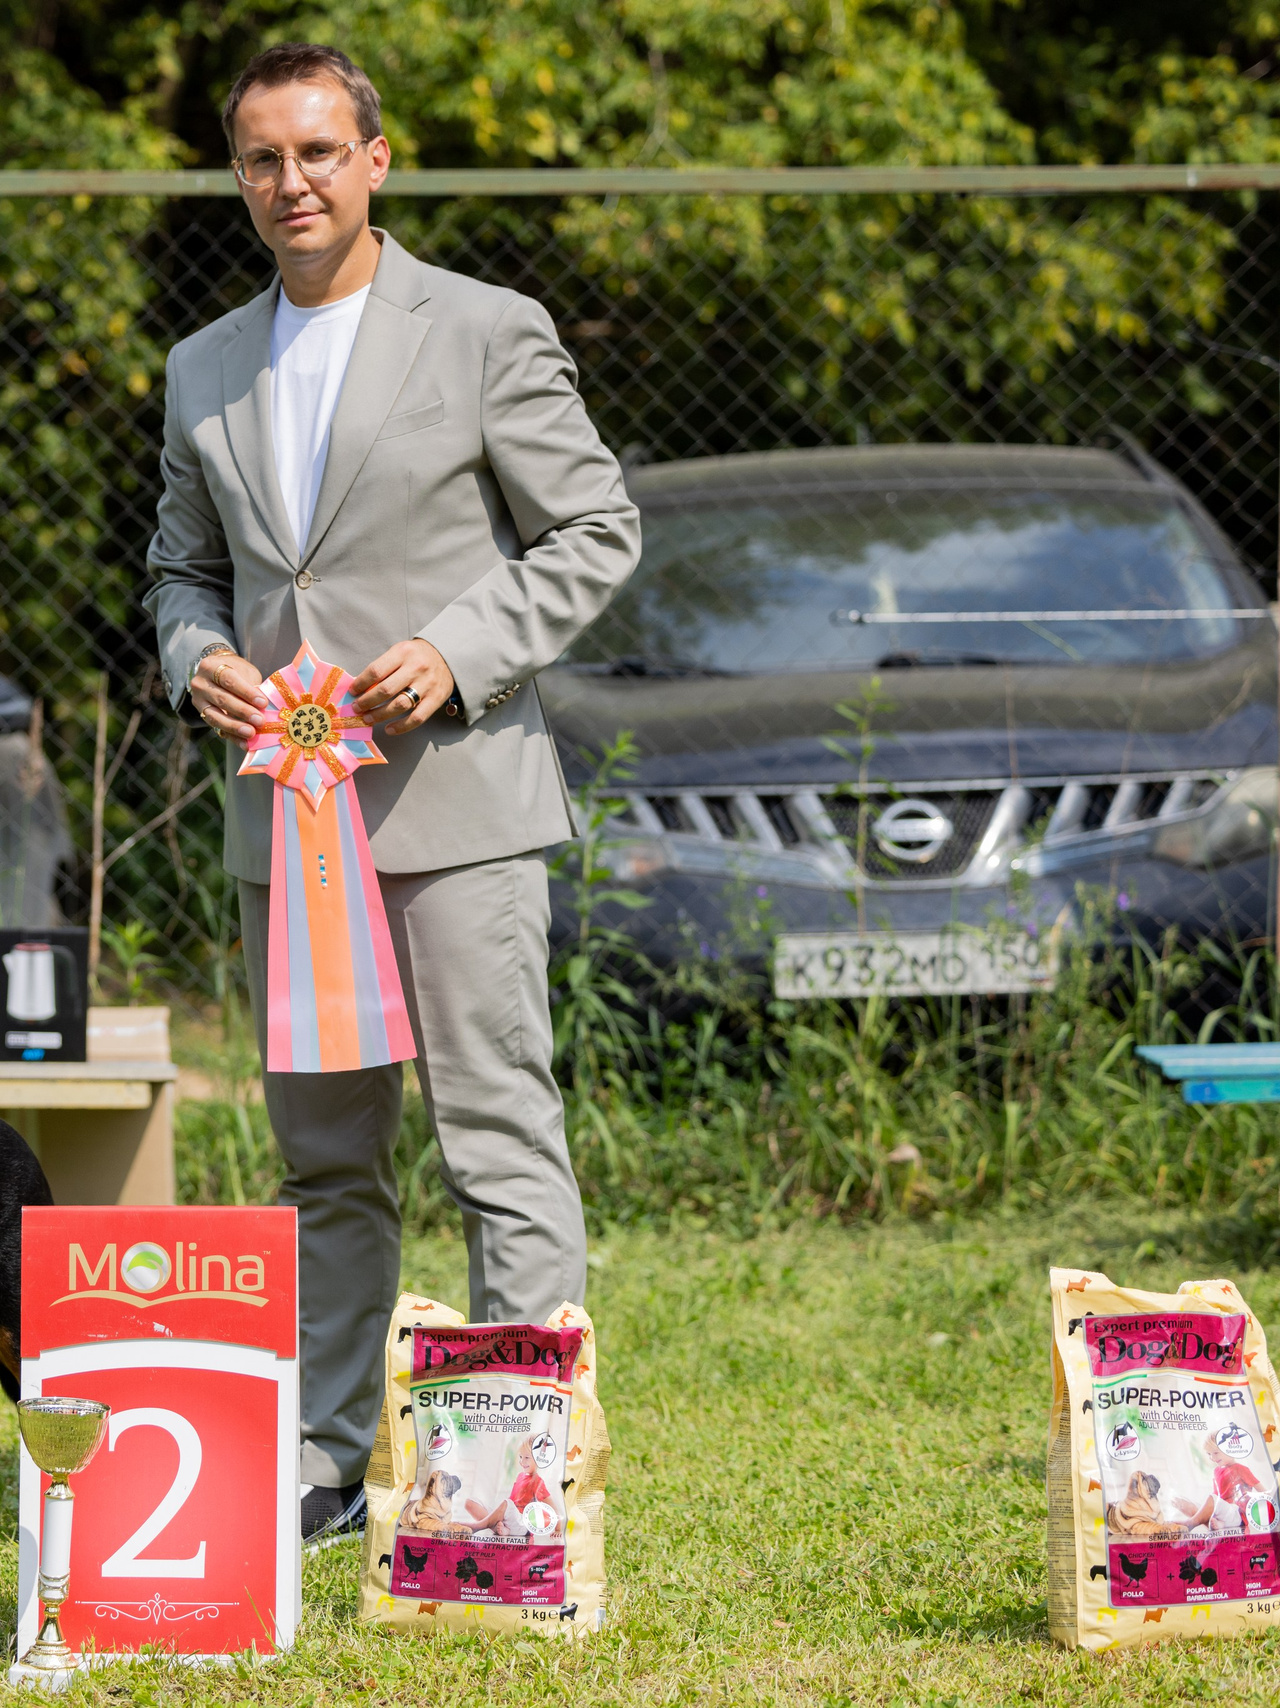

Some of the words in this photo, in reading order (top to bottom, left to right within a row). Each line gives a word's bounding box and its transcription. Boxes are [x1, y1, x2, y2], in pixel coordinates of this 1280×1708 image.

[1094, 1321, 1140, 1334] Expert
[1144, 1318, 1193, 1333] premium
[422, 1331, 465, 1344] Expert
[468, 1329, 528, 1344] premium
[1098, 1387, 1246, 1410] SUPER-POWER
[465, 1414, 485, 1423] with
[489, 1414, 528, 1424] Chicken
[1141, 1410, 1160, 1420] with
[1163, 1411, 1201, 1421] Chicken
[1138, 1421, 1160, 1429] ADULT
[101, 1407, 206, 1578] 2
[431, 1532, 463, 1540] SEMPLICE
[465, 1534, 504, 1543] ATTRAZIONE
[431, 1539, 457, 1547] SIMPLE
[460, 1541, 480, 1549] FATAL
[482, 1543, 529, 1551] ATTRACTION
[1246, 1588, 1271, 1597] ACTIVITY
[1247, 1603, 1254, 1614] 3
[1258, 1602, 1271, 1614] kg
[521, 1609, 528, 1619] 3
[532, 1609, 546, 1621] kg
